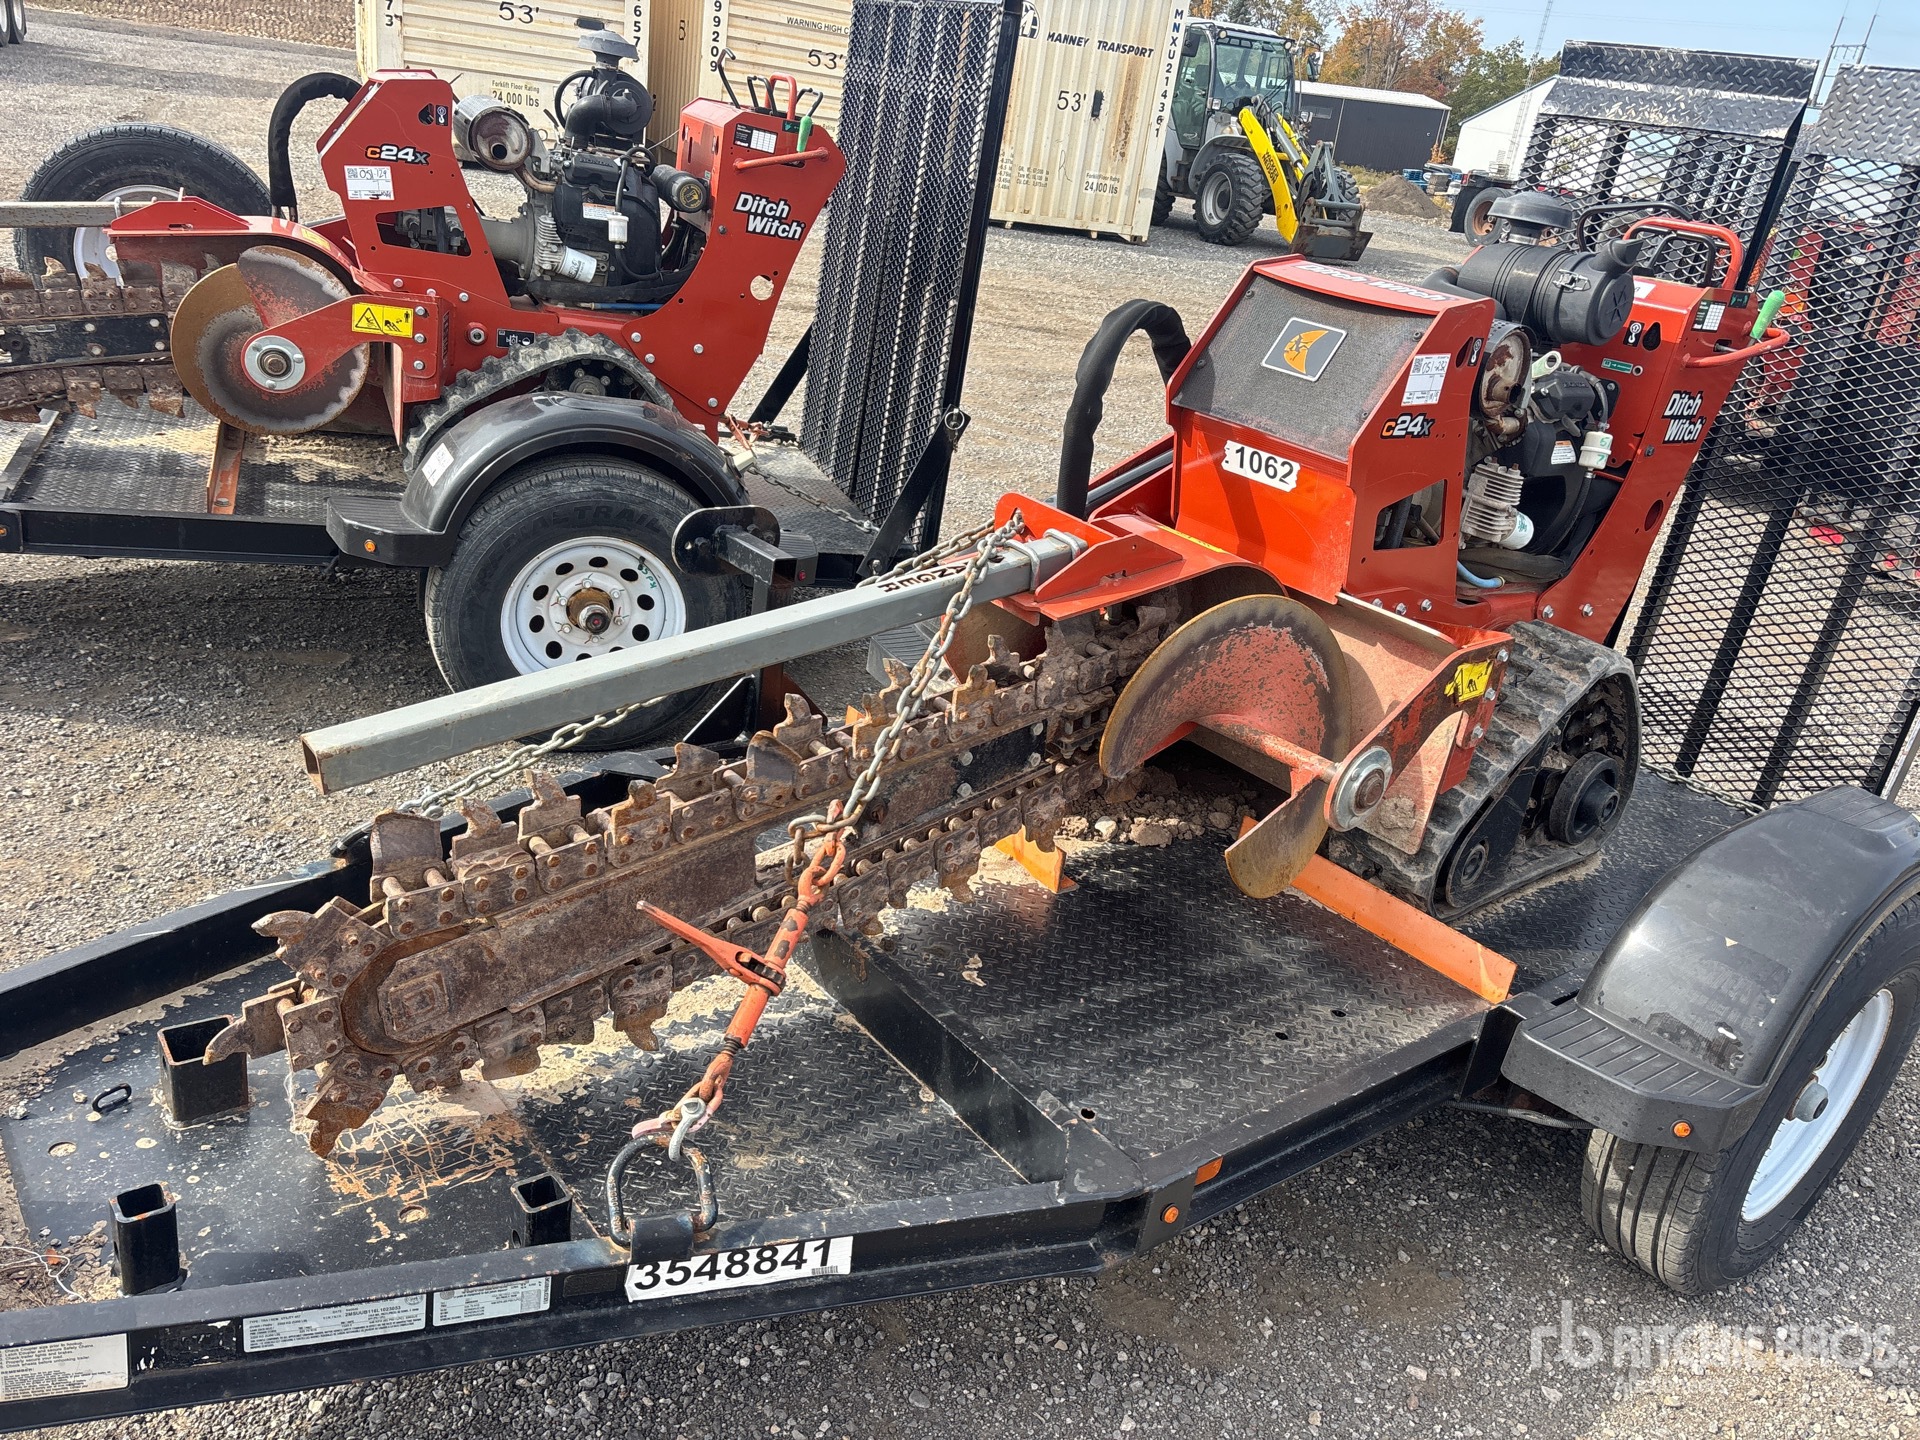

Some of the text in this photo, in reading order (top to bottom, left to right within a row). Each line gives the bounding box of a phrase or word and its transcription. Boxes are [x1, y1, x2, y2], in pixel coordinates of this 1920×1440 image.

[499, 1, 540, 25] 53'
[786, 16, 823, 30] WARNING
[824, 23, 843, 34] HIGH
[1047, 31, 1154, 58] MANNEY TRANSPORT
[807, 49, 844, 70] 53'
[491, 80, 540, 94] Forklift Floor Rating
[492, 90, 540, 108] 24,000 lbs
[1057, 90, 1087, 112] 53'
[735, 193, 790, 218] Ditch
[747, 214, 804, 239] Witch
[1663, 392, 1702, 417] Ditch
[1663, 418, 1705, 442] Witch
[1235, 446, 1294, 485] 1062
[634, 1238, 832, 1291] 3548841
